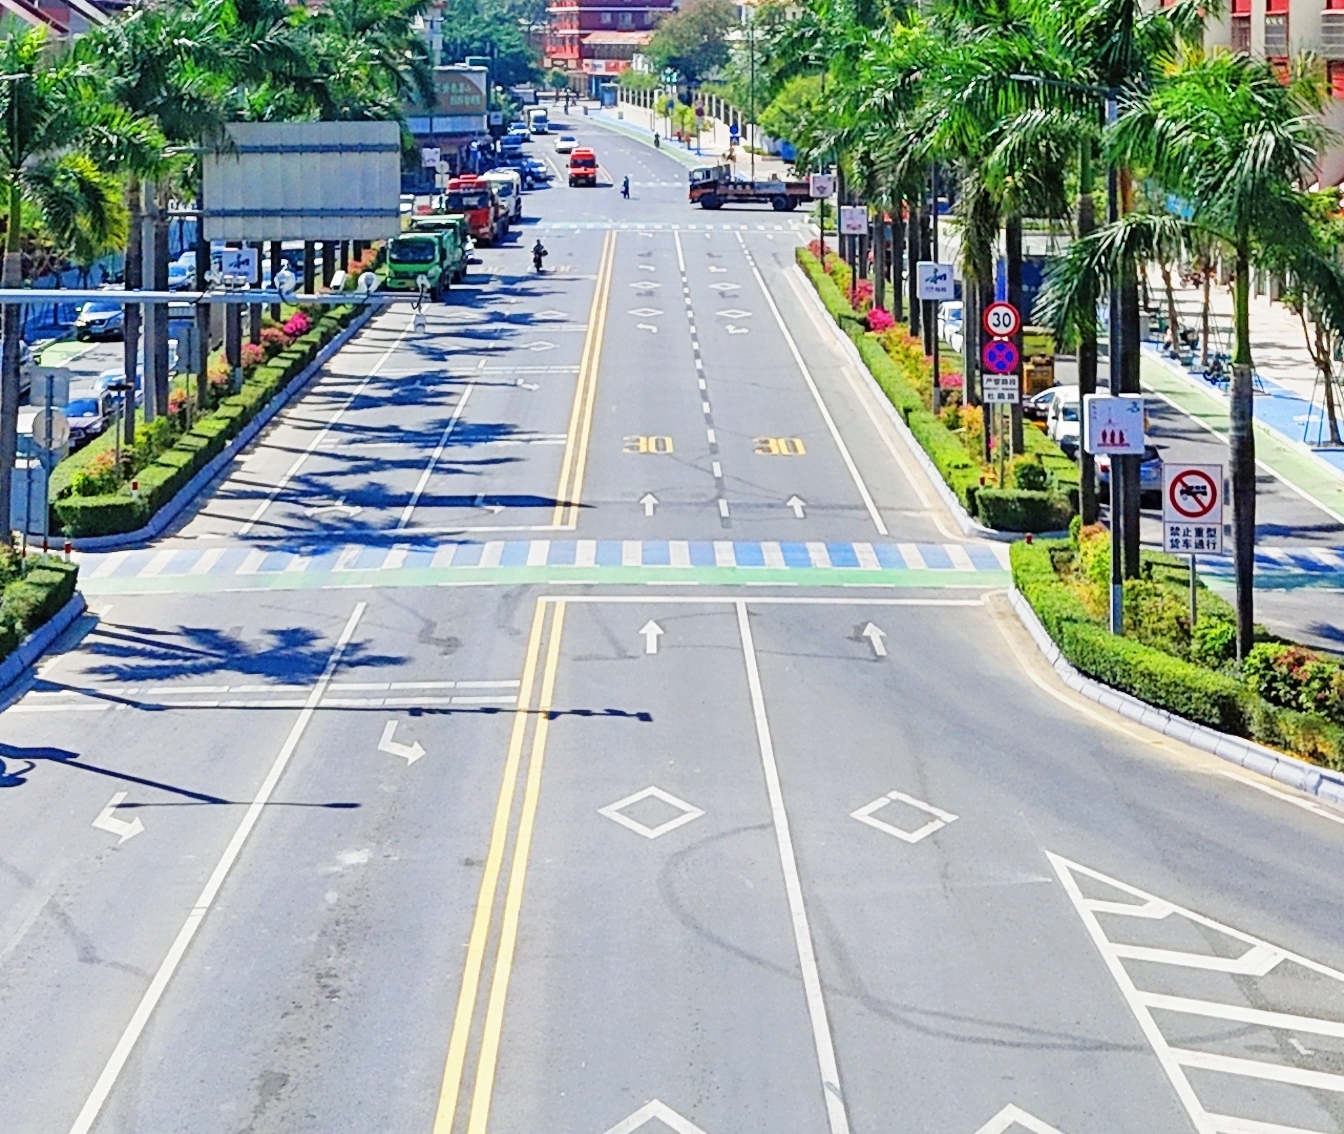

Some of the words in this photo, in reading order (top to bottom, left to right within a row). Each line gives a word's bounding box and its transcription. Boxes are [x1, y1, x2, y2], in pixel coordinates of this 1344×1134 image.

[992, 312, 1012, 328] 30
[622, 436, 674, 454] 30
[754, 438, 806, 456] 30
[1170, 527, 1217, 538] 禁止重型
[1170, 538, 1217, 550] 货车通行
